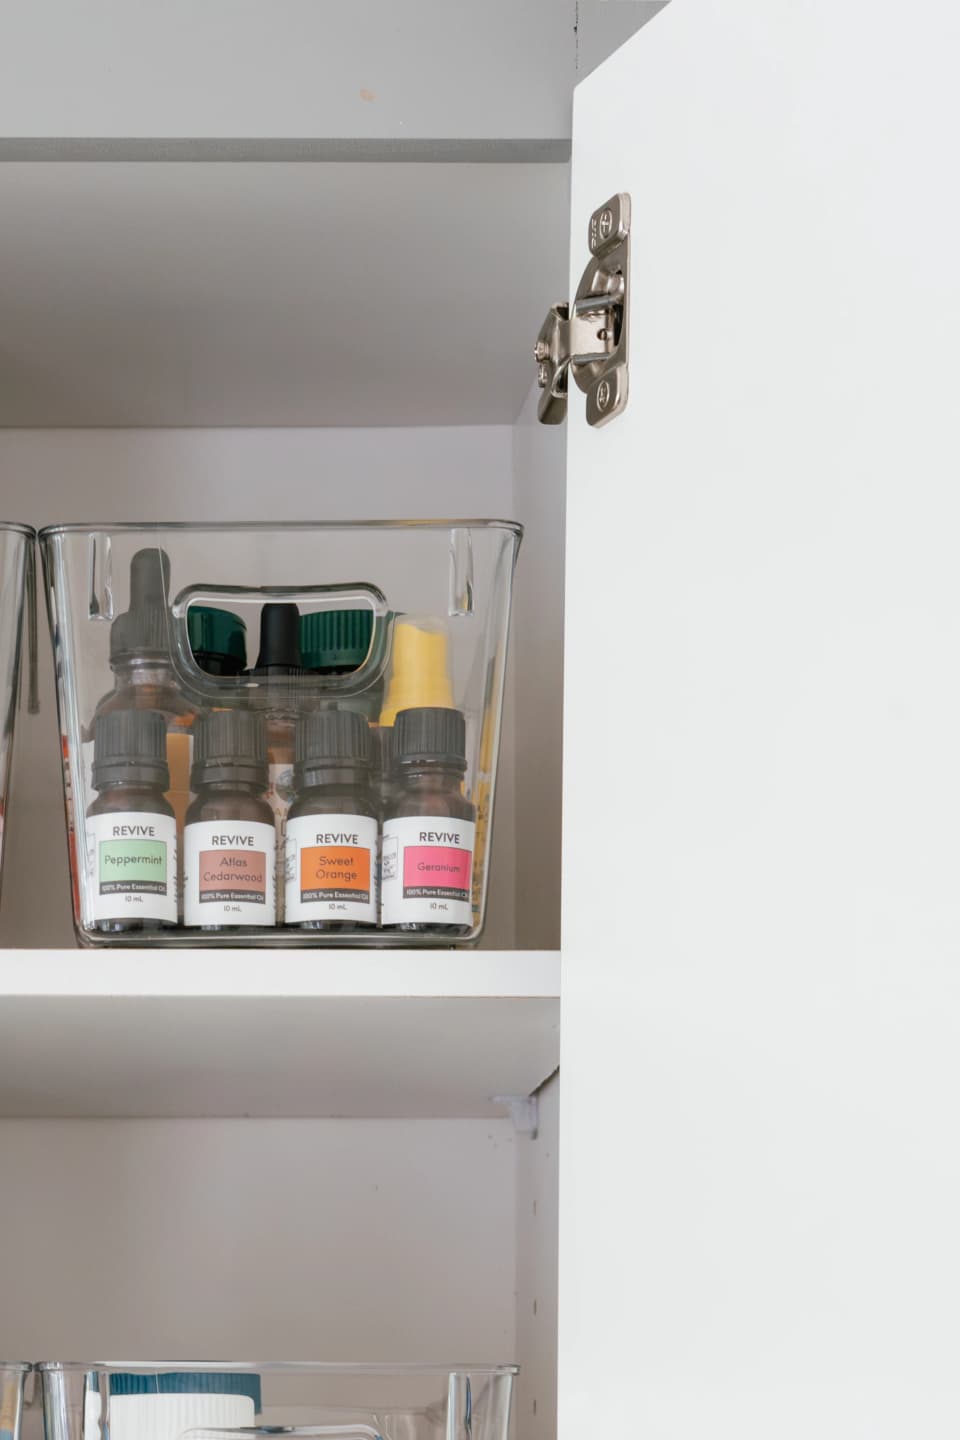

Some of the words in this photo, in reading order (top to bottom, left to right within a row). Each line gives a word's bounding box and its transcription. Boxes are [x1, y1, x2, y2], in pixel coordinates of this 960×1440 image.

[112, 826, 155, 836] REVIVE
[212, 836, 254, 846] REVIVE
[316, 834, 359, 844] REVIVE
[420, 832, 460, 844] REVIVE
[104, 855, 162, 868] Peppermint
[219, 856, 248, 867] Atlas
[320, 856, 354, 866] Sweet
[417, 862, 461, 873] Geranium
[203, 872, 262, 882] Cedarwood
[316, 869, 357, 881] Orange
[406, 888, 422, 896] 100%
[422, 888, 436, 896] Pure
[224, 904, 230, 912] 10
[430, 902, 436, 910] 10
